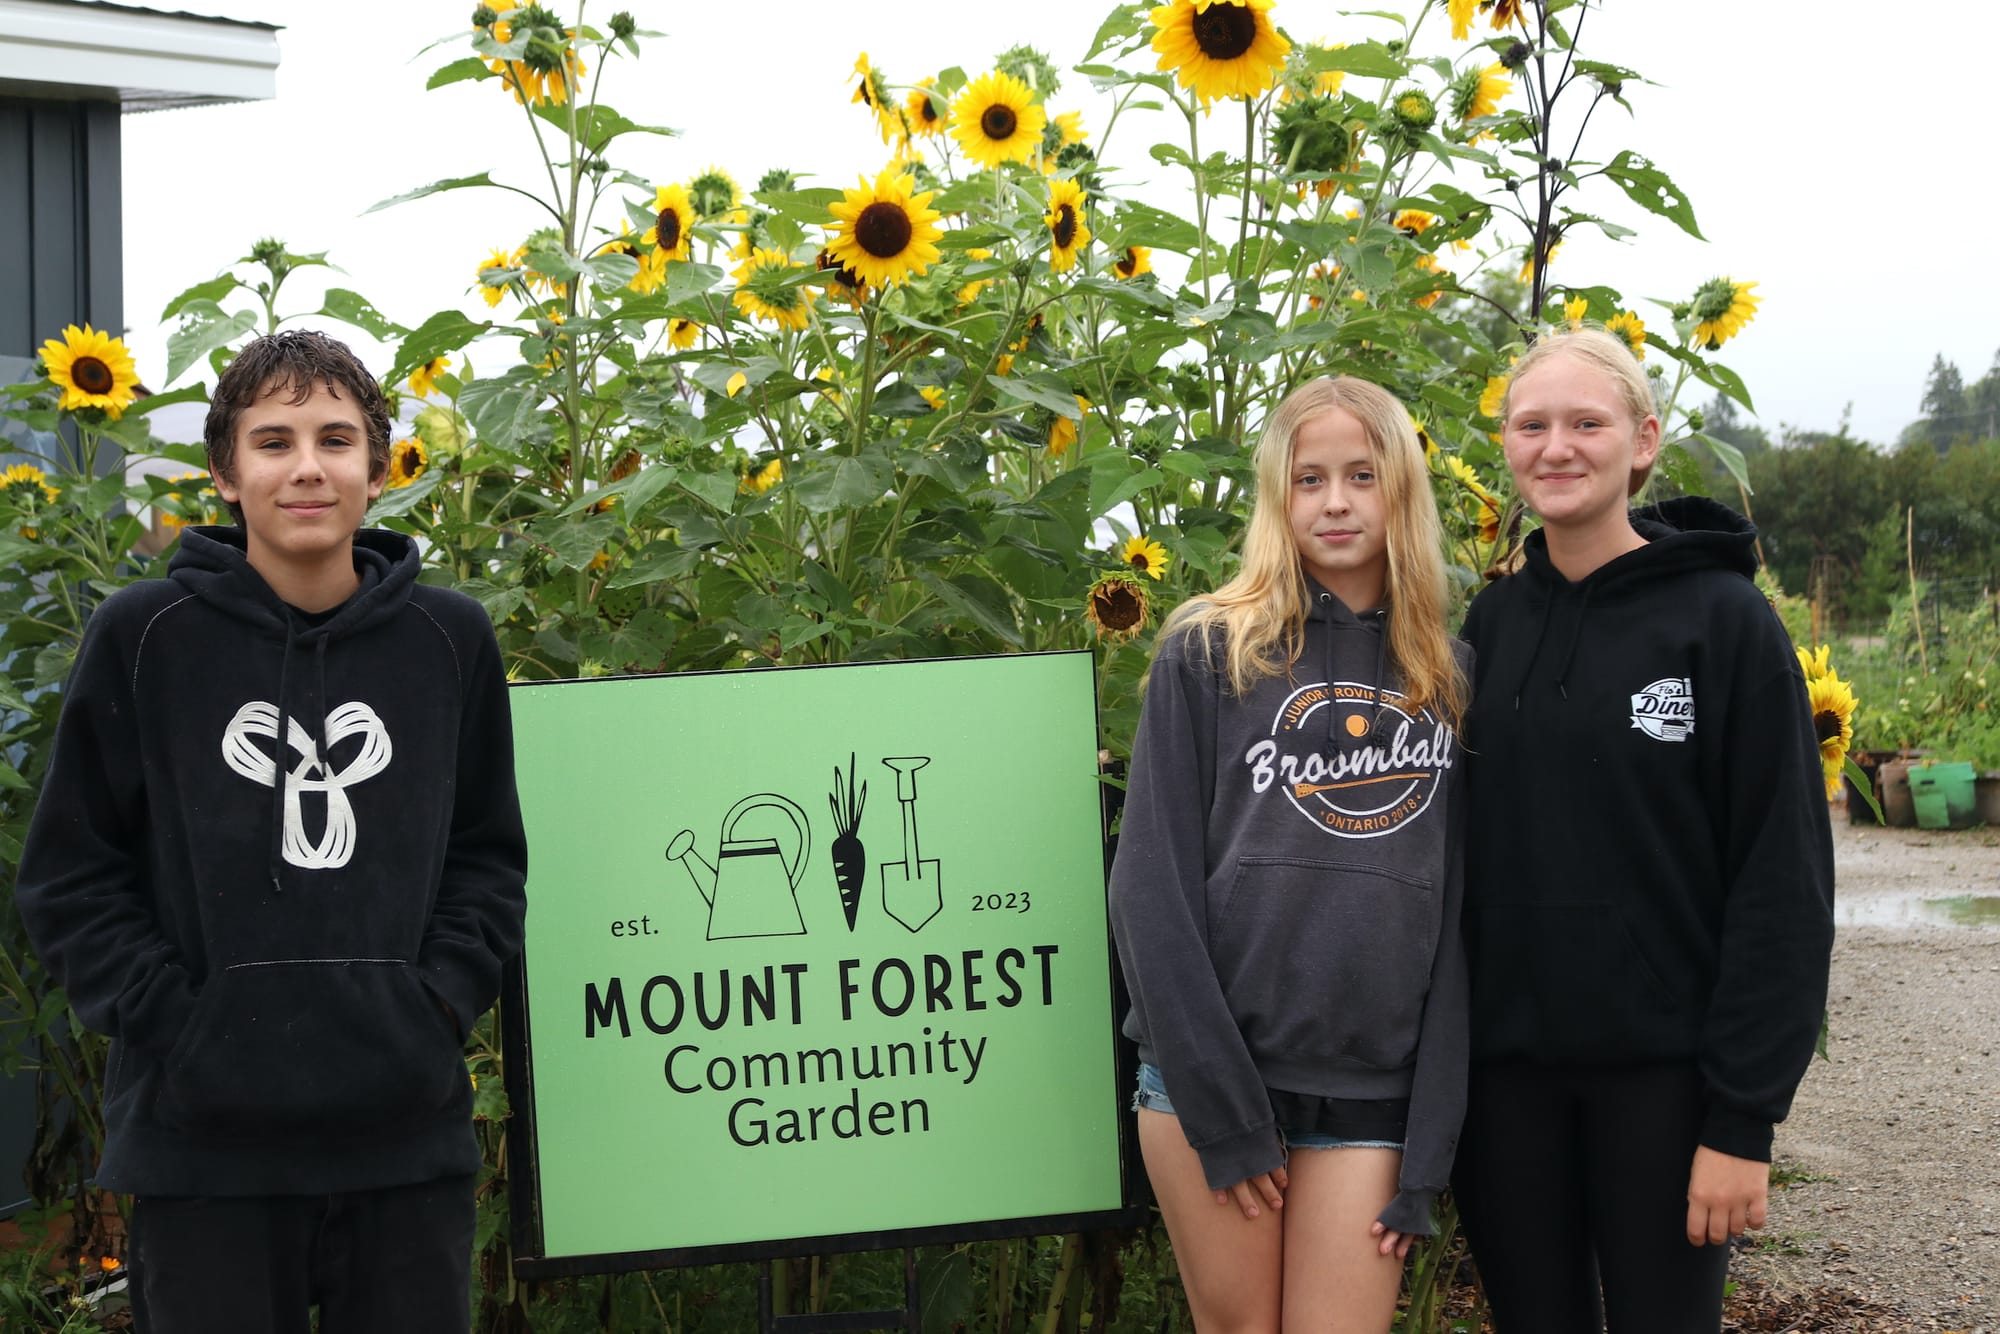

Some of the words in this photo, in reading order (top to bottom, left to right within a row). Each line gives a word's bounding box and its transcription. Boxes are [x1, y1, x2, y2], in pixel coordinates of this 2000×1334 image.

[1284, 691, 1324, 724] JUNIOR
[1635, 695, 1694, 717] Diner
[1245, 719, 1453, 794] Broomball
[1326, 812, 1390, 832] ONTARIO
[1391, 798, 1418, 823] 2018
[611, 915, 660, 938] est.
[971, 891, 1032, 914] 2023
[585, 962, 808, 1039] MOUNT
[838, 944, 1059, 1021] FOREST
[664, 1026, 988, 1094] Community
[728, 1087, 930, 1147] Garden
